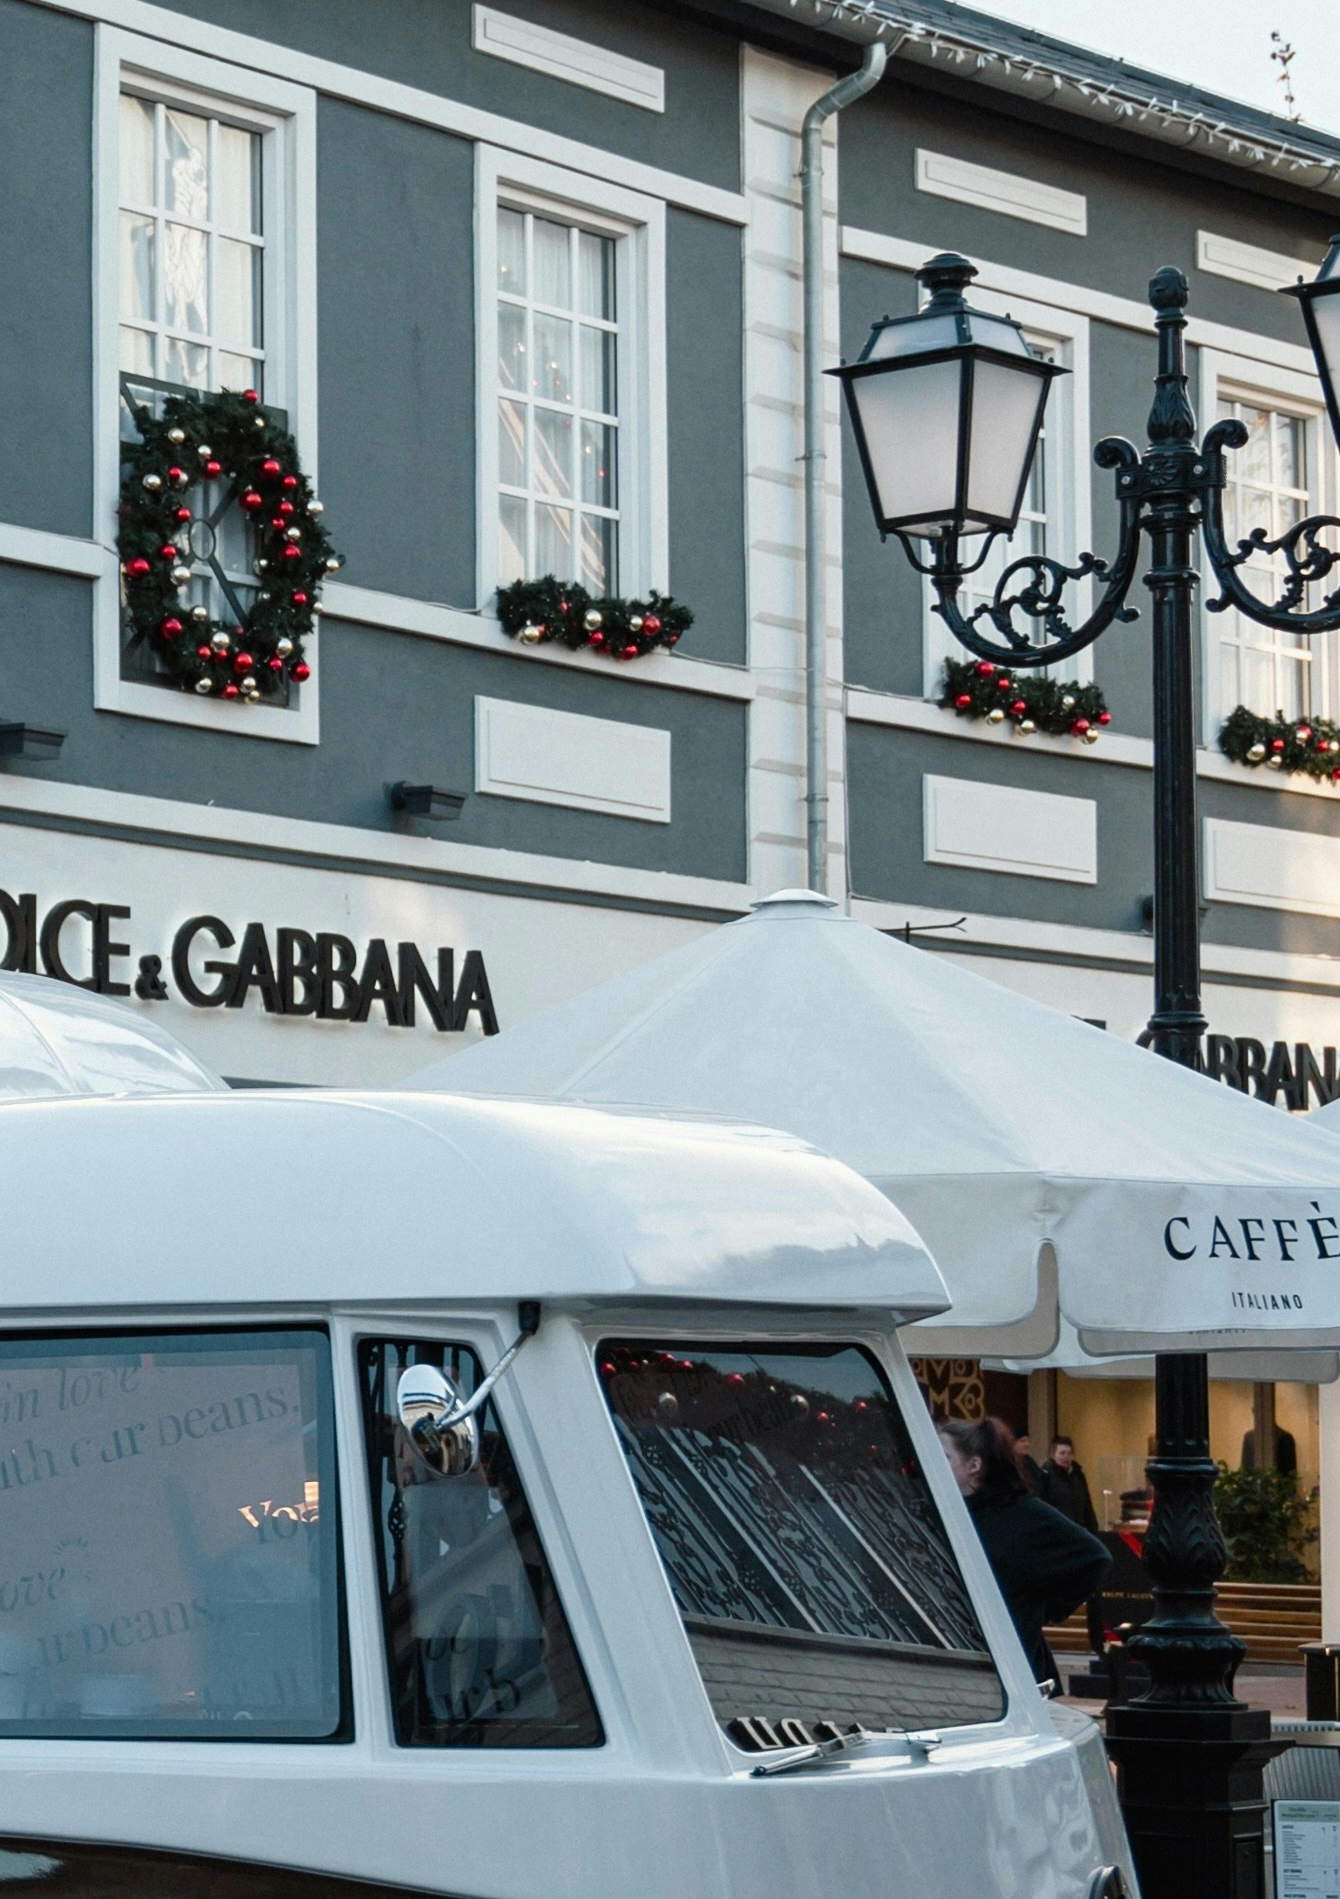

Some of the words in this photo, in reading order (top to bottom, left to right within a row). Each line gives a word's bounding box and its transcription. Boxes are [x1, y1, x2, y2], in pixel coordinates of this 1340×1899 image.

[134, 954, 169, 1001] &
[171, 915, 500, 1037] GABBANA
[1163, 1201, 1340, 1262] CAFFÈ
[1230, 1291, 1304, 1310] ITALIANO
